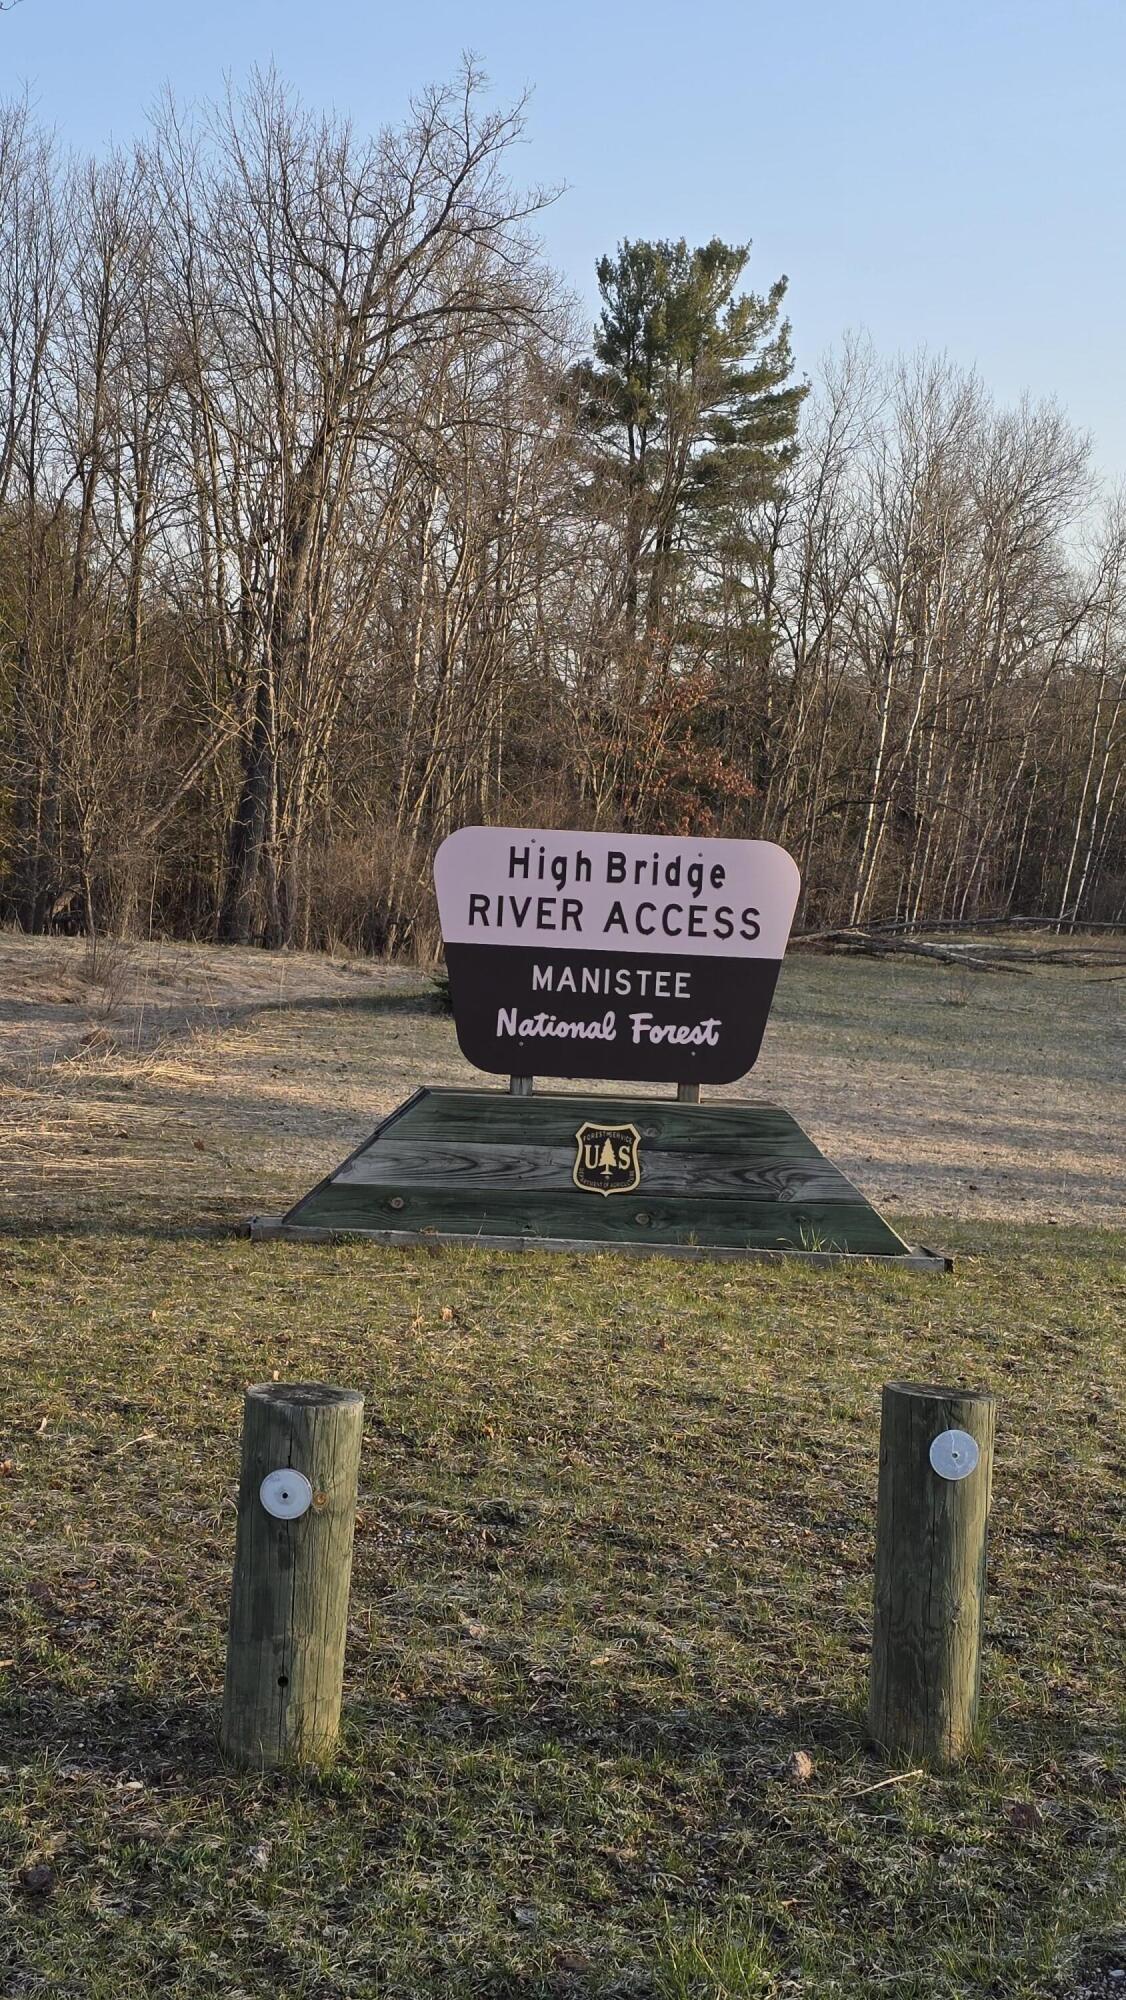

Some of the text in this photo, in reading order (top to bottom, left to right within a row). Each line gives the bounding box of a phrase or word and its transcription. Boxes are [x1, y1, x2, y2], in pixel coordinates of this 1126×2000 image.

[508, 845, 726, 898] High Bridge
[468, 893, 761, 941] RIVER ACCESS
[532, 964, 691, 998] MANISTEE
[496, 1007, 722, 1046] National Forest
